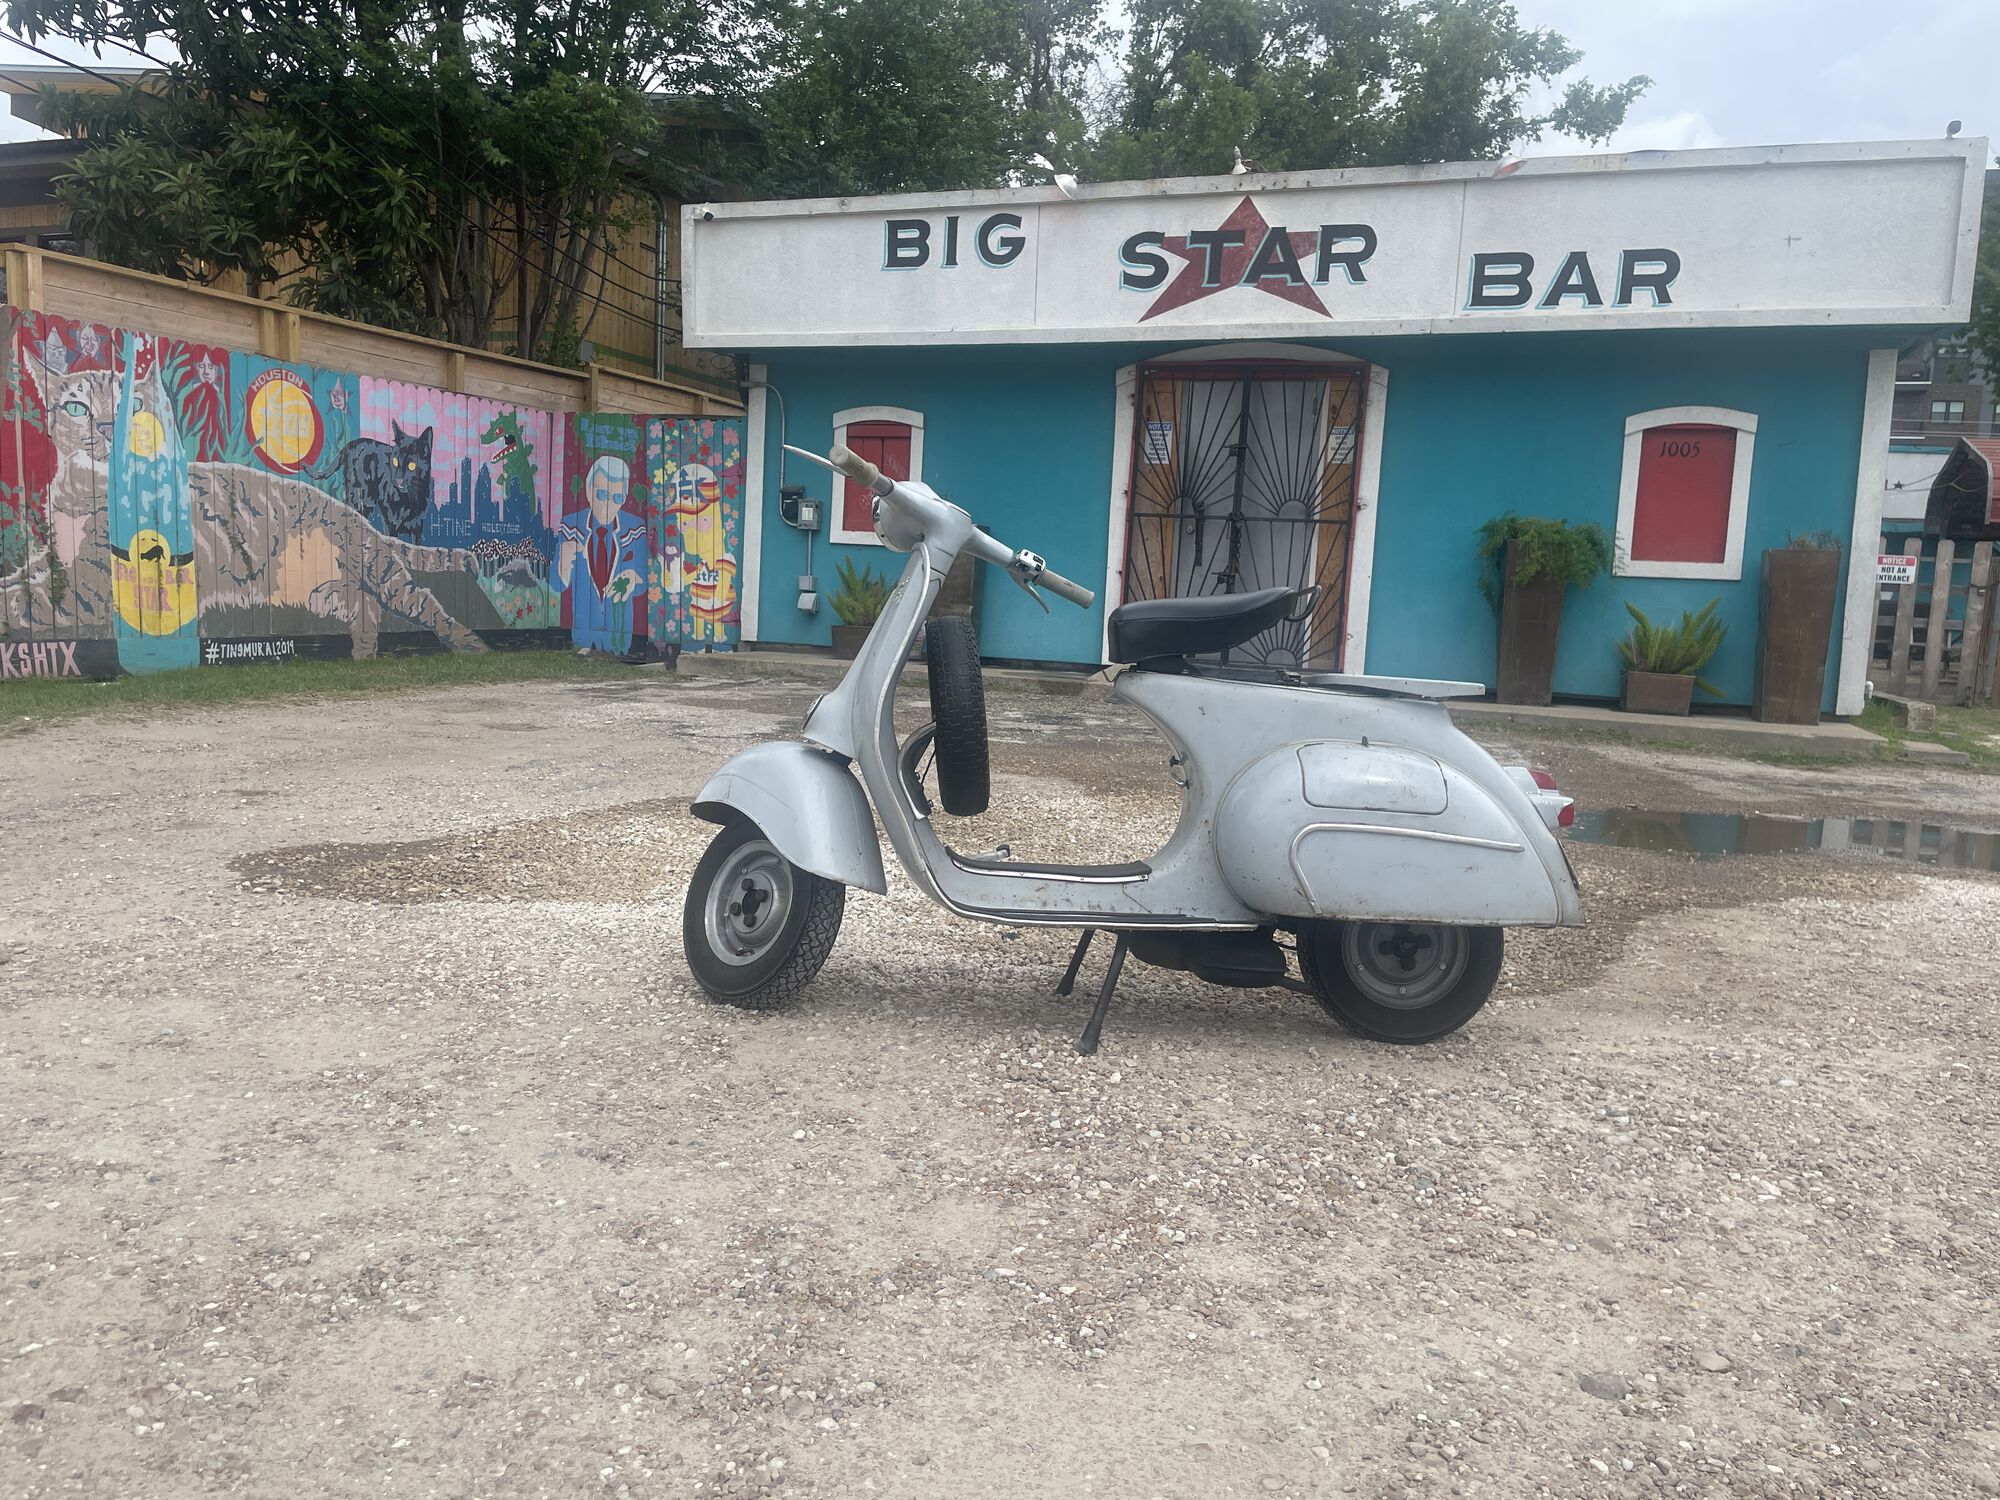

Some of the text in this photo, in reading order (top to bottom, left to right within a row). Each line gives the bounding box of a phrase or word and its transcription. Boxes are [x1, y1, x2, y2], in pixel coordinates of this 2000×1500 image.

[882, 212, 1681, 311] BIG STAR BAR
[251, 369, 303, 392] HOUSTON
[1659, 440, 1701, 458] 1005
[1881, 566, 1895, 574] NOT
[1882, 557, 1907, 565] NOTICE
[165, 567, 194, 585] BR
[0, 641, 82, 679] KSHTX
